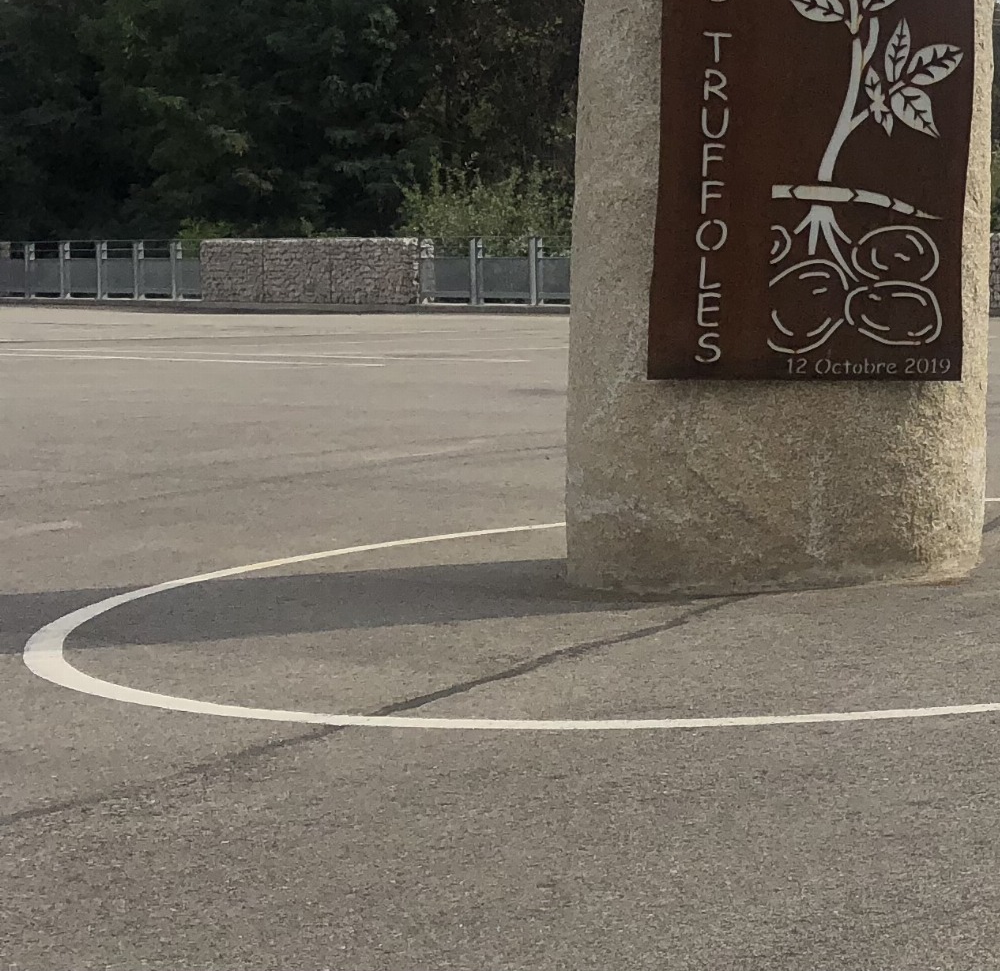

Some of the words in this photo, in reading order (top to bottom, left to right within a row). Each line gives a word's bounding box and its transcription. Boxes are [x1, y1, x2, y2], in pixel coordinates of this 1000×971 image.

[694, 30, 733, 364] TRUFFOLES
[786, 357, 808, 374] 12
[814, 357, 898, 375] Octobre
[904, 357, 951, 375] 2019
